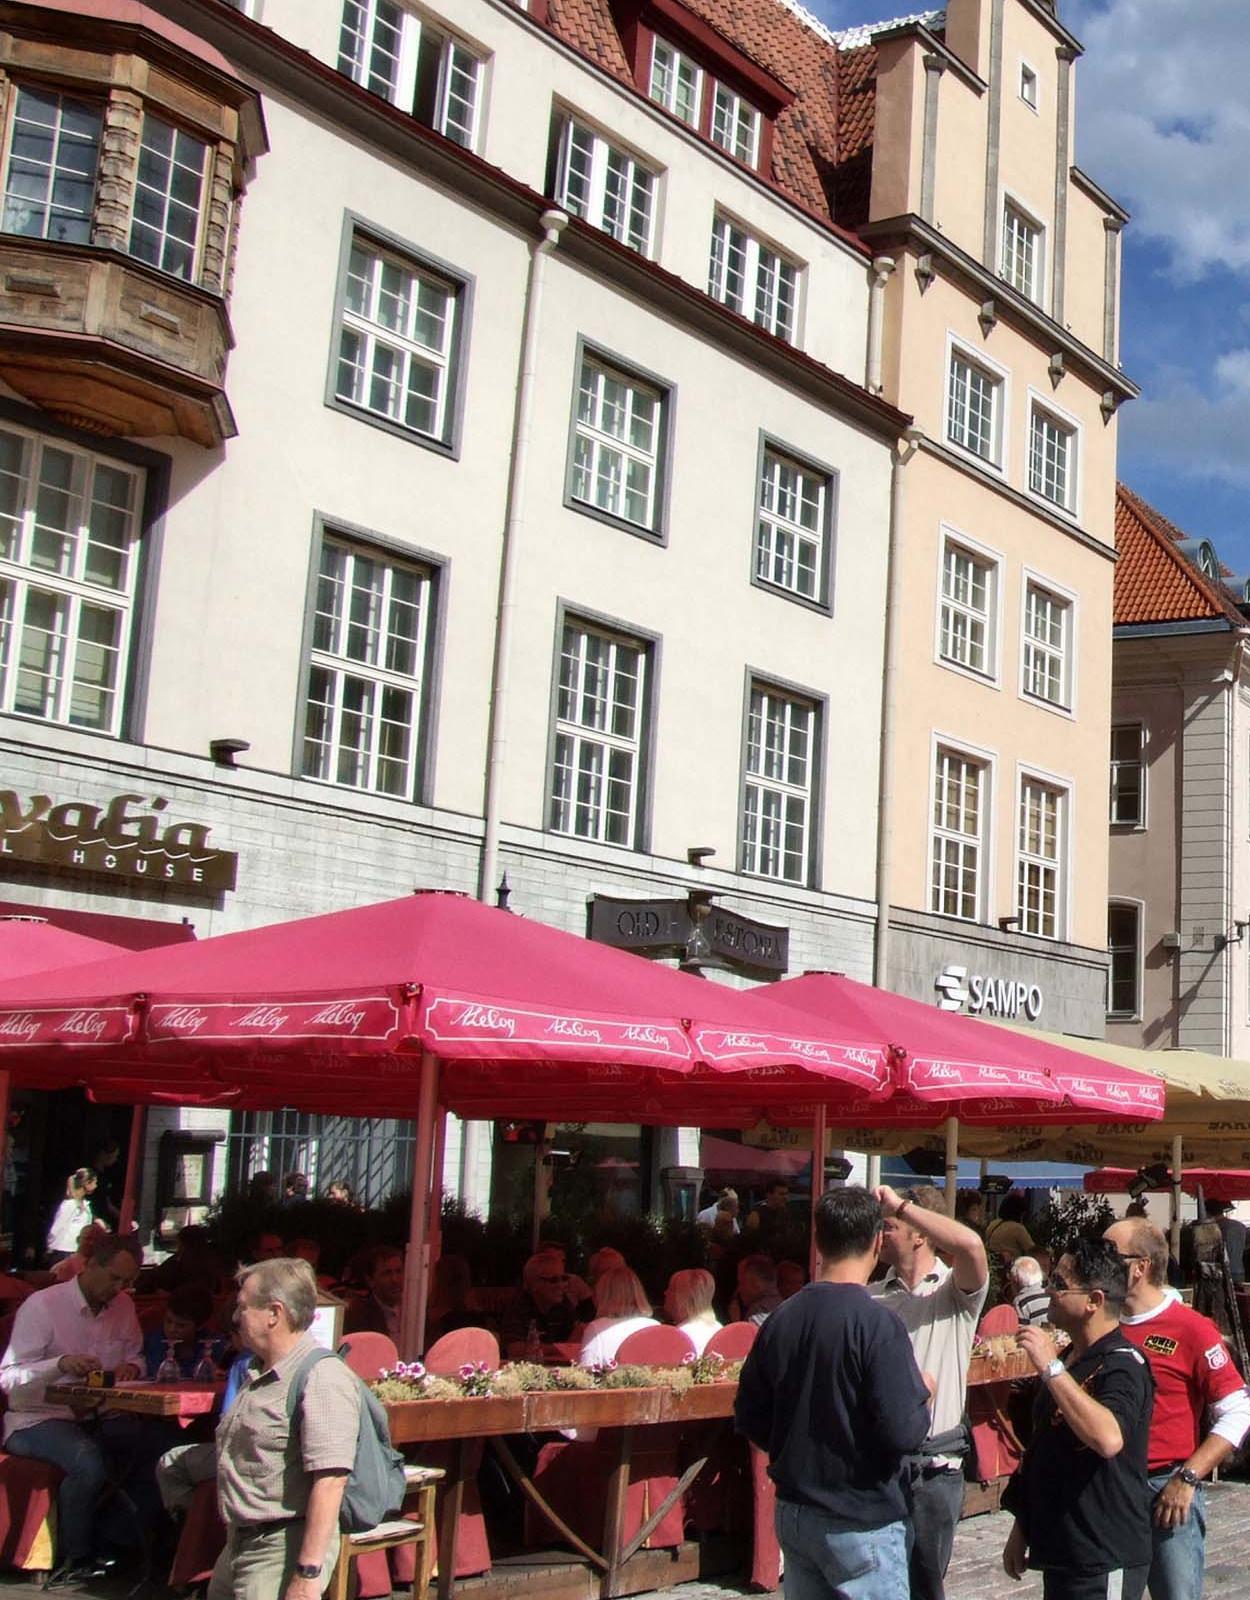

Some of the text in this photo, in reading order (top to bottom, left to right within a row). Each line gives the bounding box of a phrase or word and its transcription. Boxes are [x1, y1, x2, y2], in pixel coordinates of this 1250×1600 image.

[72, 849, 204, 882] HOUSE
[617, 911, 660, 937] OLD
[968, 975, 1043, 1022] SAMPO
[1147, 1334, 1177, 1350] POWER
